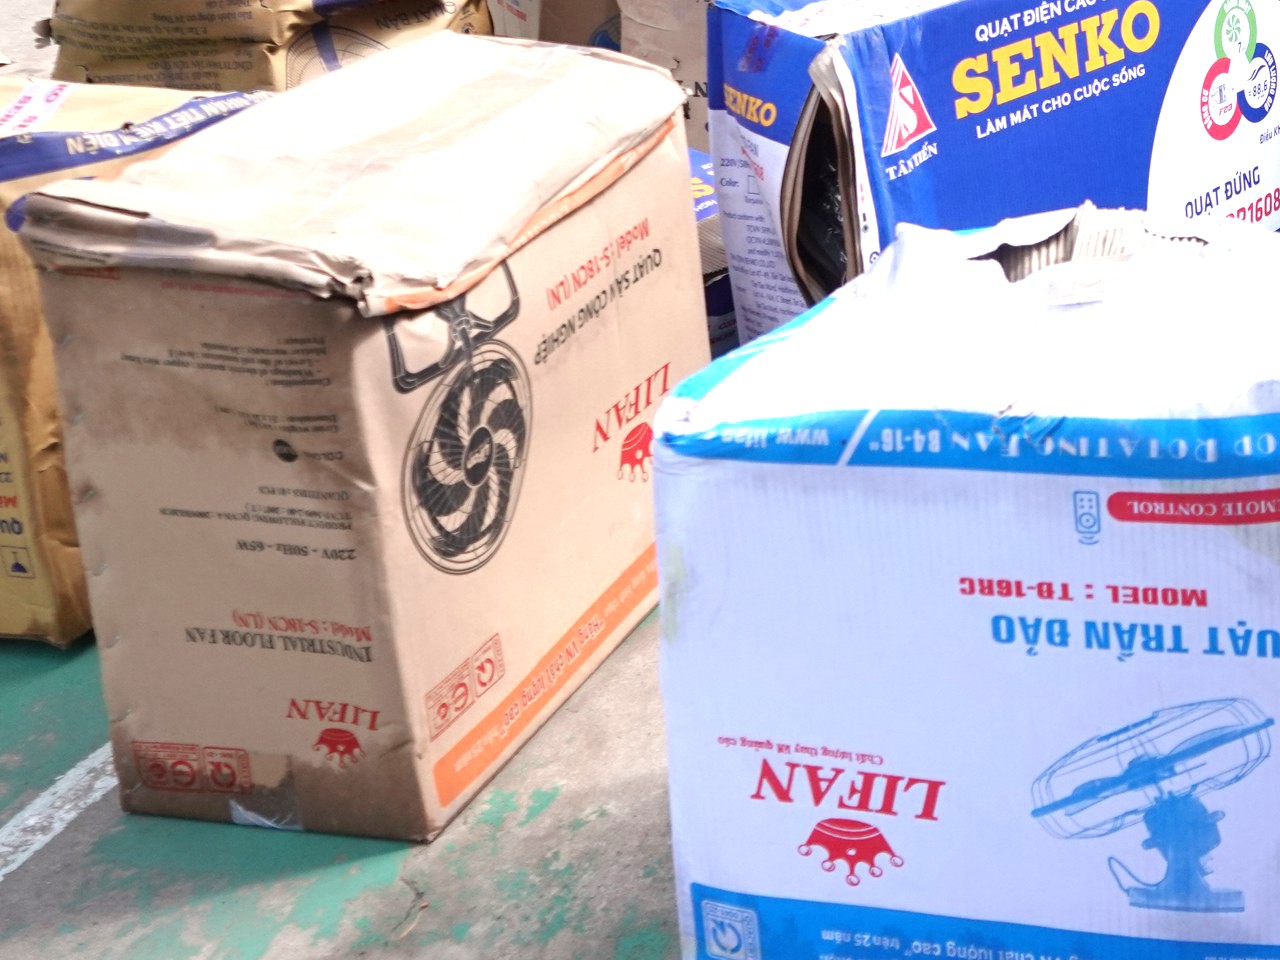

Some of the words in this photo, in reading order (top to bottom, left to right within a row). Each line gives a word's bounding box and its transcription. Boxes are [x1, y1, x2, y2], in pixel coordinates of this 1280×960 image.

[975, 13, 1021, 43] QUẠT
[976, 118, 1008, 140] LÀM
[1009, 103, 1040, 126] MÁT
[1042, 92, 1072, 114] CHO
[1073, 77, 1111, 102] CUỘC
[1111, 63, 1146, 88] SỐNG
[885, 152, 914, 182] TÂN
[913, 141, 939, 166] TIẾN
[1224, 165, 1261, 200] ĐỨNG
[616, 218, 650, 259] Model
[571, 246, 611, 287] S-18CN
[632, 248, 663, 283] QUẠT
[546, 273, 571, 311] (LN)
[577, 293, 609, 330] CÔNG
[534, 317, 576, 366] NGHIỆP
[592, 361, 671, 453] LIFAN
[1127, 500, 1218, 518] CONTROL
[236, 539, 265, 553] 65W
[275, 542, 309, 557] 50Hz
[321, 547, 357, 562] 220V
[958, 576, 1074, 603] TĐ-16RC
[1105, 585, 1208, 608] MODEL
[184, 626, 217, 644] FAN
[267, 615, 319, 633] S-18CN
[330, 621, 373, 642] Model
[990, 615, 1071, 658] ĐẢO
[216, 628, 275, 651] FLOOR
[283, 635, 373, 664] INDUSTRIAL
[566, 642, 580, 661] VN
[1084, 621, 1190, 663] TRẦN
[285, 698, 381, 732] LIFAN
[717, 736, 738, 749] cáo
[794, 743, 819, 758] thay
[821, 746, 853, 763] lượng
[855, 752, 884, 767] Chất
[750, 757, 947, 822] LIFAN
[820, 929, 851, 944] năm
[853, 932, 871, 947] 25
[872, 934, 901, 950] trên
